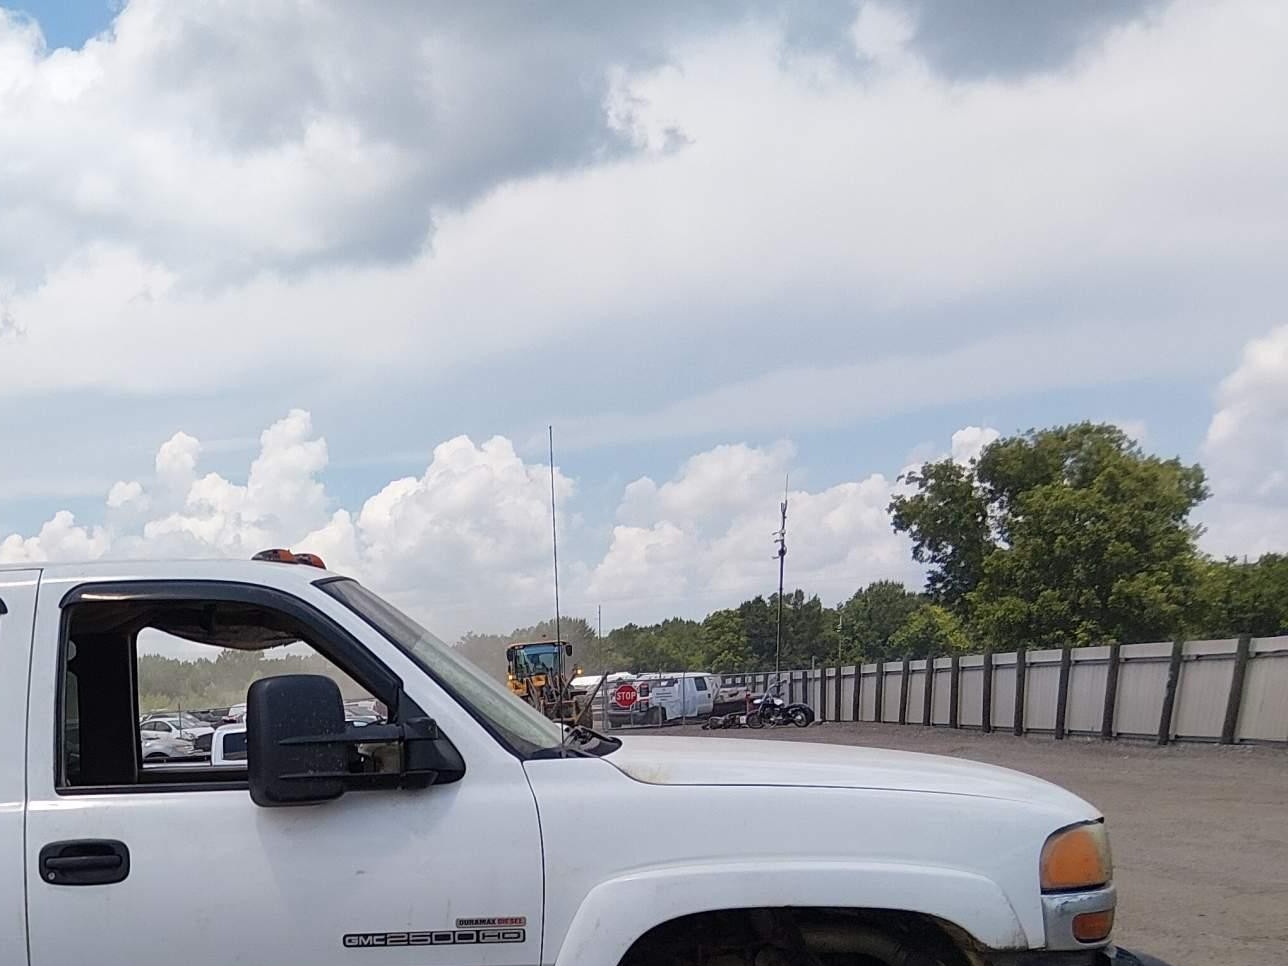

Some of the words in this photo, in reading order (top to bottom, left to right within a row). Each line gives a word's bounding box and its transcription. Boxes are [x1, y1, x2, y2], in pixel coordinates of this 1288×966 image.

[616, 691, 636, 700] STOP
[459, 918, 496, 926] DURAMAX
[345, 935, 386, 946] GMC
[387, 931, 477, 945] 2500
[480, 930, 523, 942] HD
